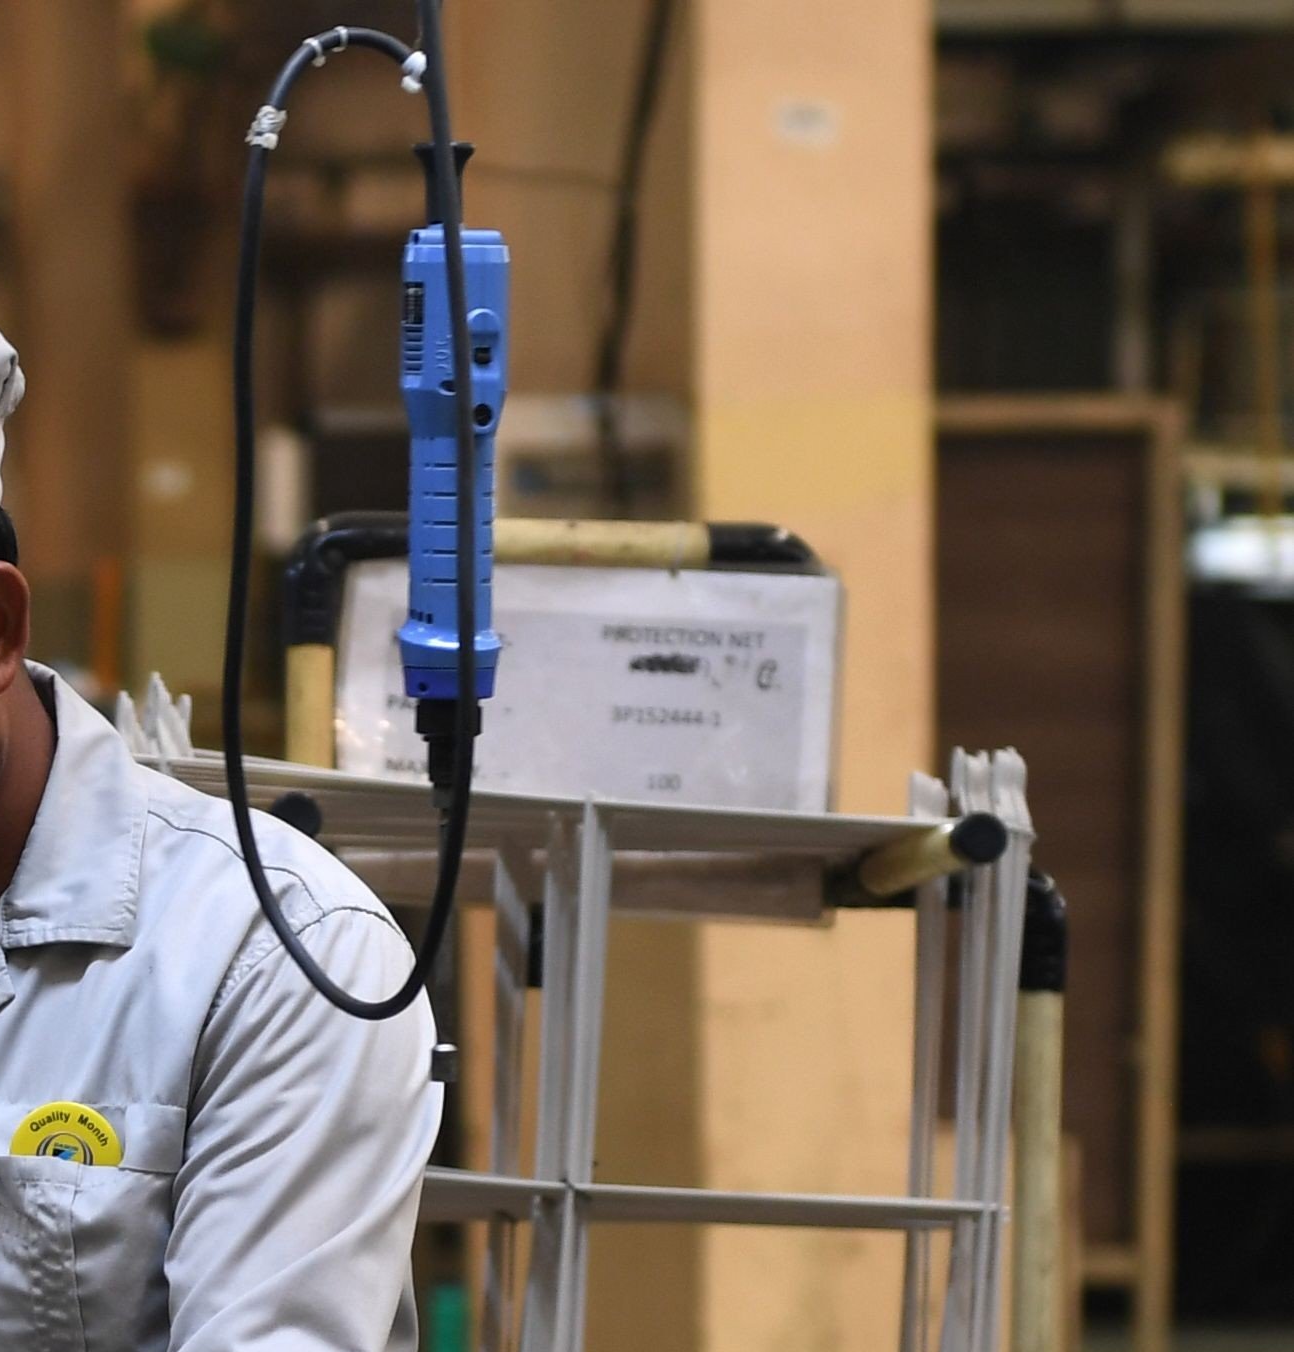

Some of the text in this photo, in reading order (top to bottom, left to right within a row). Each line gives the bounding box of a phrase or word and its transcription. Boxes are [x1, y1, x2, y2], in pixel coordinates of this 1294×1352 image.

[602, 625, 766, 649] PROTECTION NET
[647, 773, 682, 791] 100
[30, 1110, 110, 1147] Quality Month
